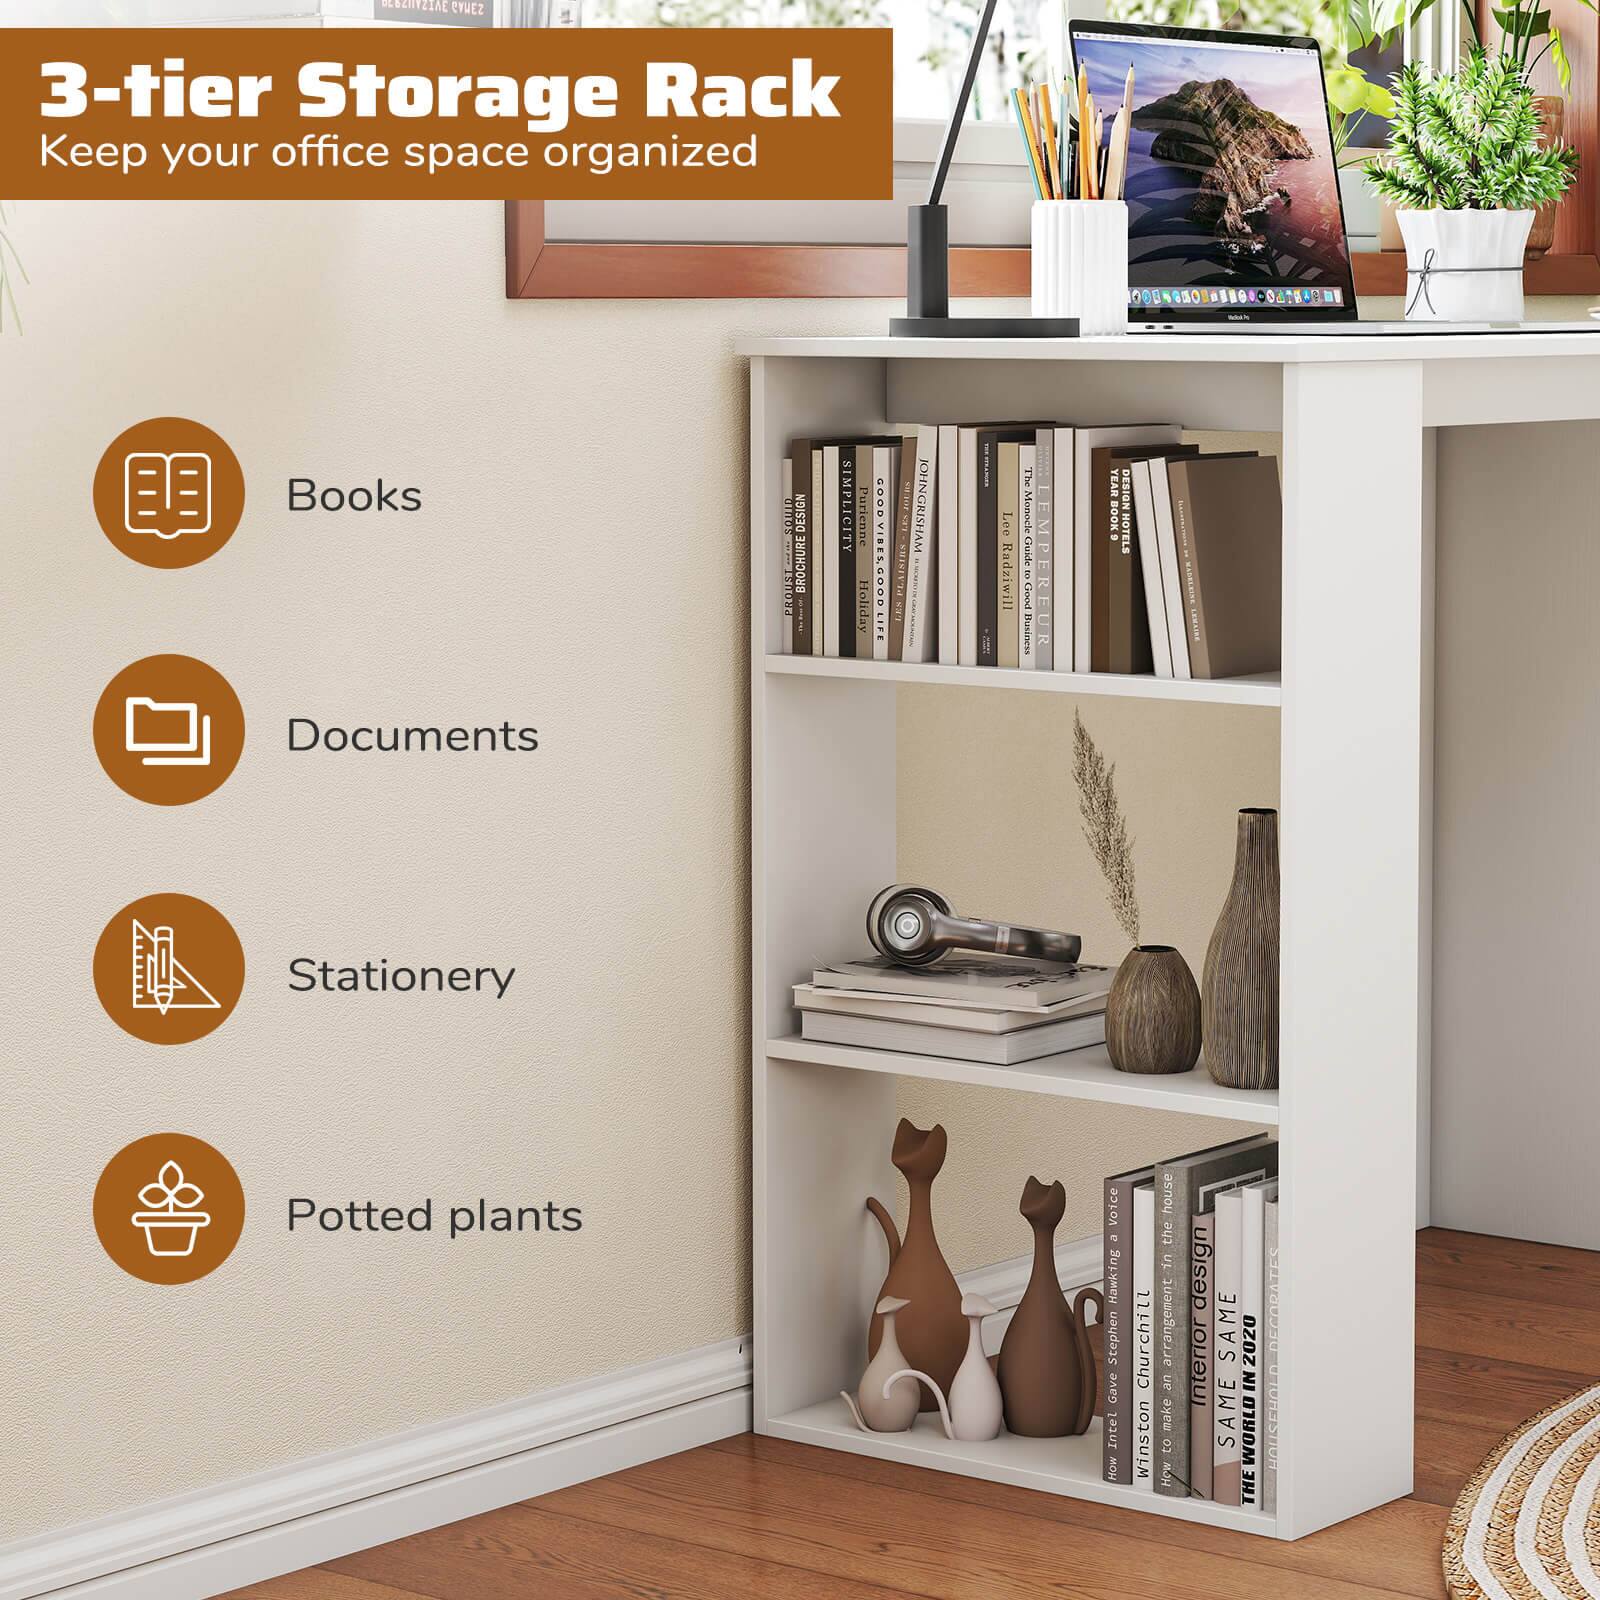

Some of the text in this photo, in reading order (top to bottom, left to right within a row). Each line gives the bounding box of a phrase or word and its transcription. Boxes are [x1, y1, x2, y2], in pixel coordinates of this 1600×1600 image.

[785, 497, 793, 535] SQUID
[795, 494, 806, 593] BROCHURE DESIGN
[842, 459, 852, 553] SIMPLICITY
[1110, 468, 1119, 497] YEAR
[1110, 500, 1118, 531] BOOK
[1121, 468, 1130, 555] DESIGN HOTELS
[785, 570, 793, 616] PROUST
[857, 487, 869, 633] Purienne Holiday
[1002, 512, 1013, 611] Lee Radziwill
[1023, 467, 1032, 655] The Monocle Guide to Good Business
[1037, 485, 1049, 646] LEMPEREUR
[1107, 1187, 1121, 1481] How Intel Gave Stephen Hawking a Voice
[1137, 1289, 1150, 1479] Winston Churchill
[1161, 1173, 1175, 1487] How to make an arrangement in the house
[1190, 1227, 1212, 1406] Interior design
[1217, 1291, 1236, 1448] SAME SAME
[1241, 1314, 1256, 1505] THE WORLD IN 2020
